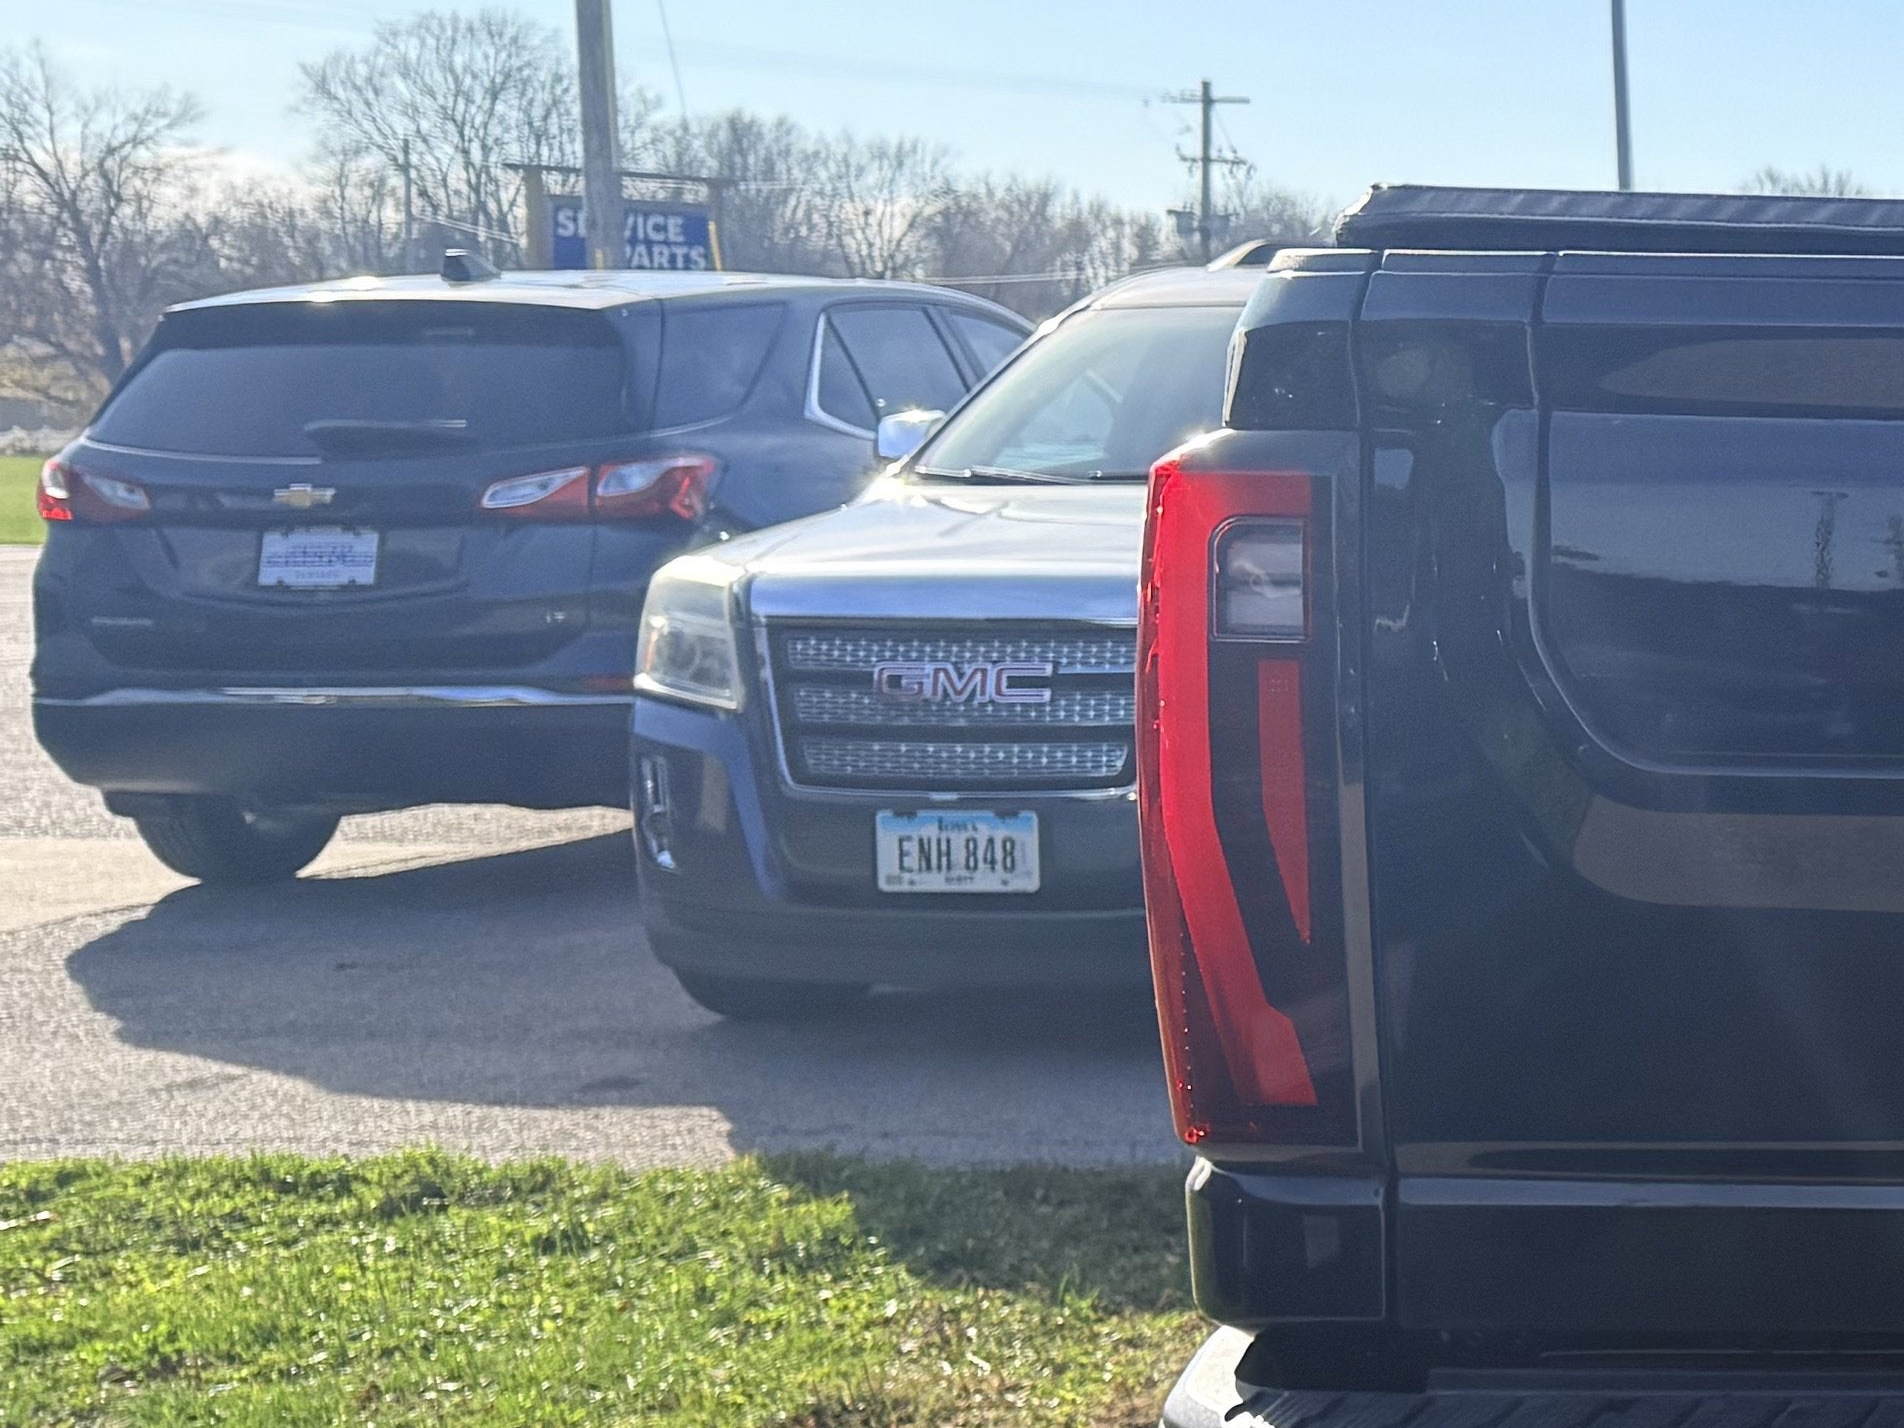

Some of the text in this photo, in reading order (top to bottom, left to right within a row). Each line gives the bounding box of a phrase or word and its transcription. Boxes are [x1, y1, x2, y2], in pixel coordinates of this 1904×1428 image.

[626, 243, 707, 269] ARTS
[874, 661, 1053, 703] GMC
[898, 836, 1016, 874] ENH 848
